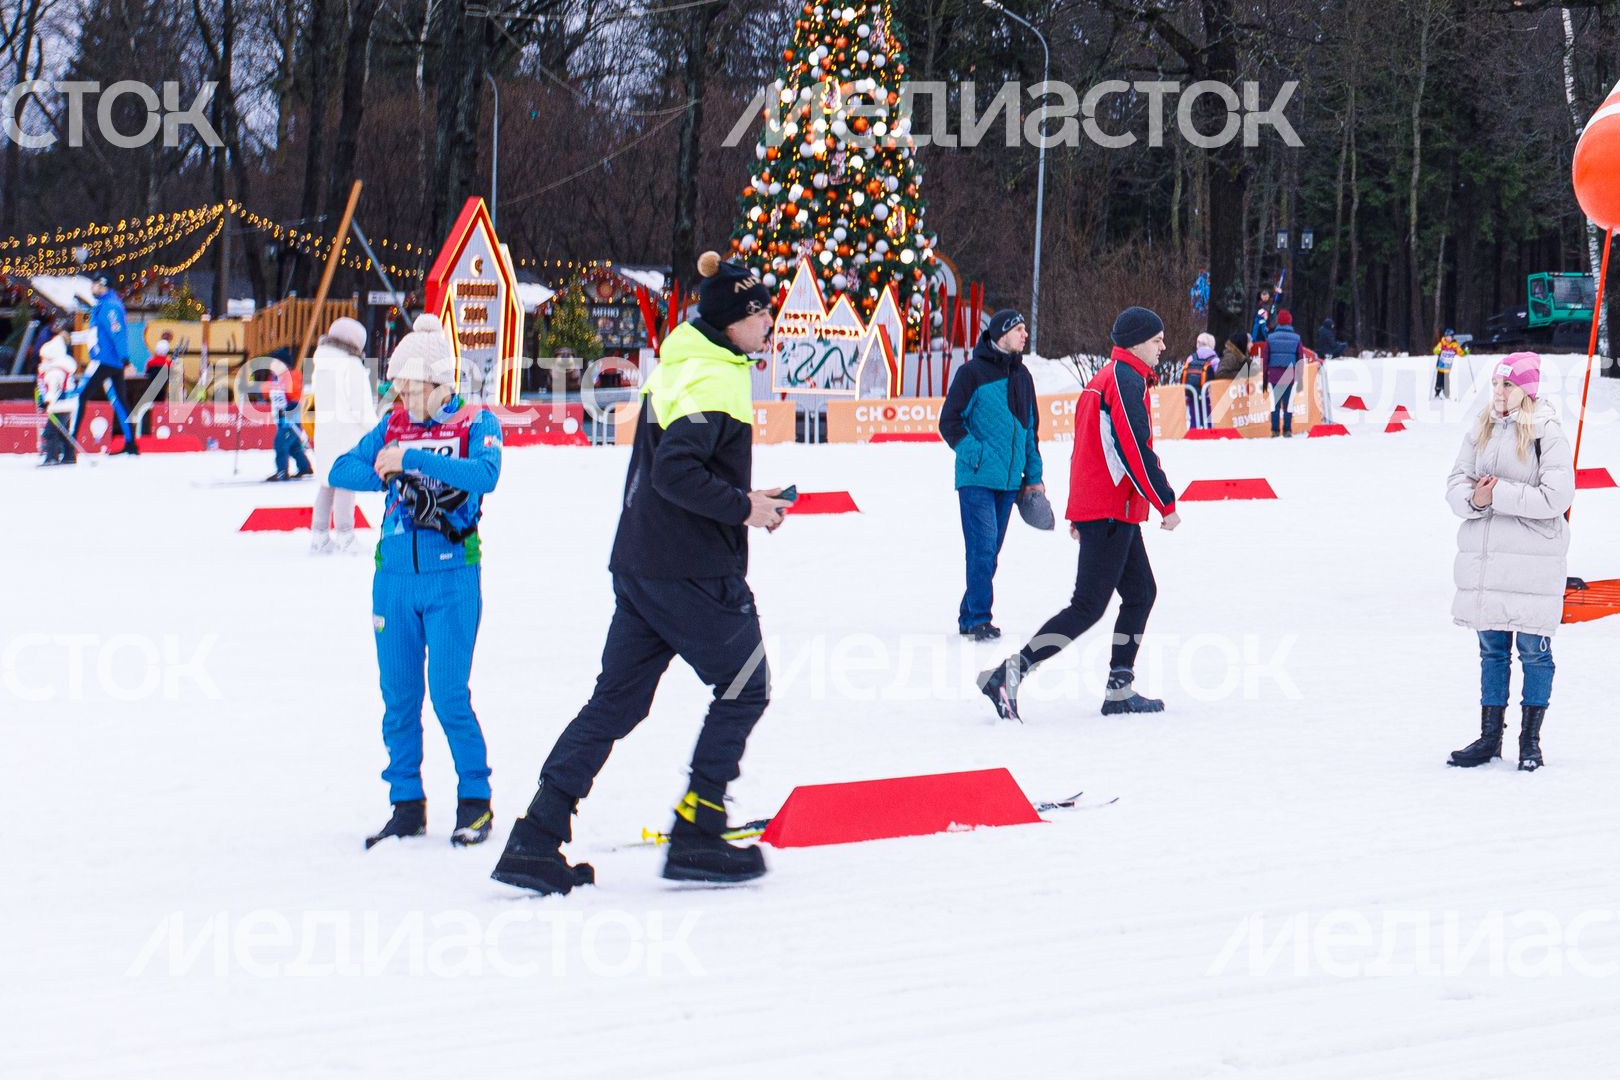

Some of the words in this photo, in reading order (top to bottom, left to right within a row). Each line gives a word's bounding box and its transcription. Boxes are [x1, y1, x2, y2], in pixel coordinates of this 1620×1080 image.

[592, 307, 620, 318] МЕНЮ
[784, 311, 821, 322] ПОЧТА
[813, 327, 860, 338] МОРОЗА
